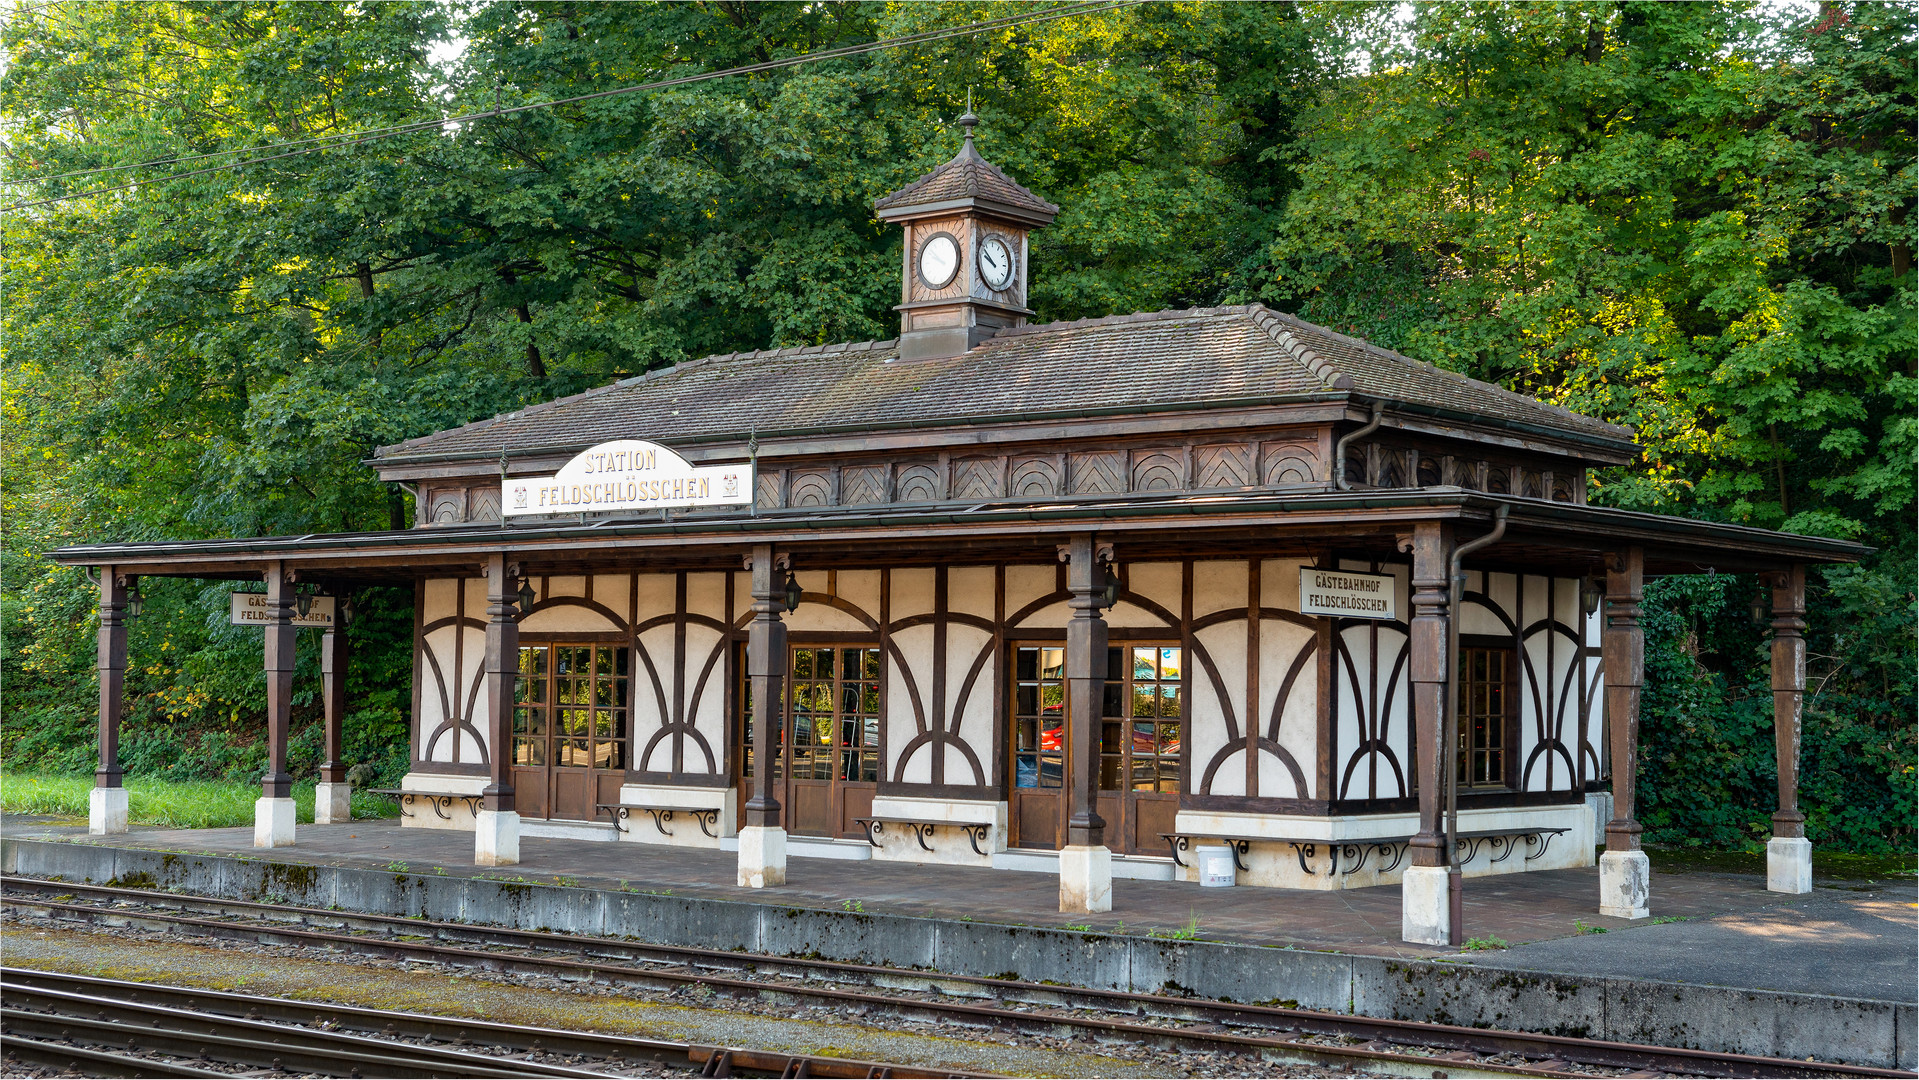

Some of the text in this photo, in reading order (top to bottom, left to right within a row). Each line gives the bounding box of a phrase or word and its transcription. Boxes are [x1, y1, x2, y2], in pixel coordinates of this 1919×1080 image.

[585, 449, 656, 474] STATION
[539, 476, 710, 506] FELDSCHLÖSSCHEN
[1316, 573, 1380, 592] GÄSTEBAHNHOF
[1309, 594, 1387, 612] FELDSCHLÖSSCHEN
[241, 610, 326, 621] FELDSSHEN
